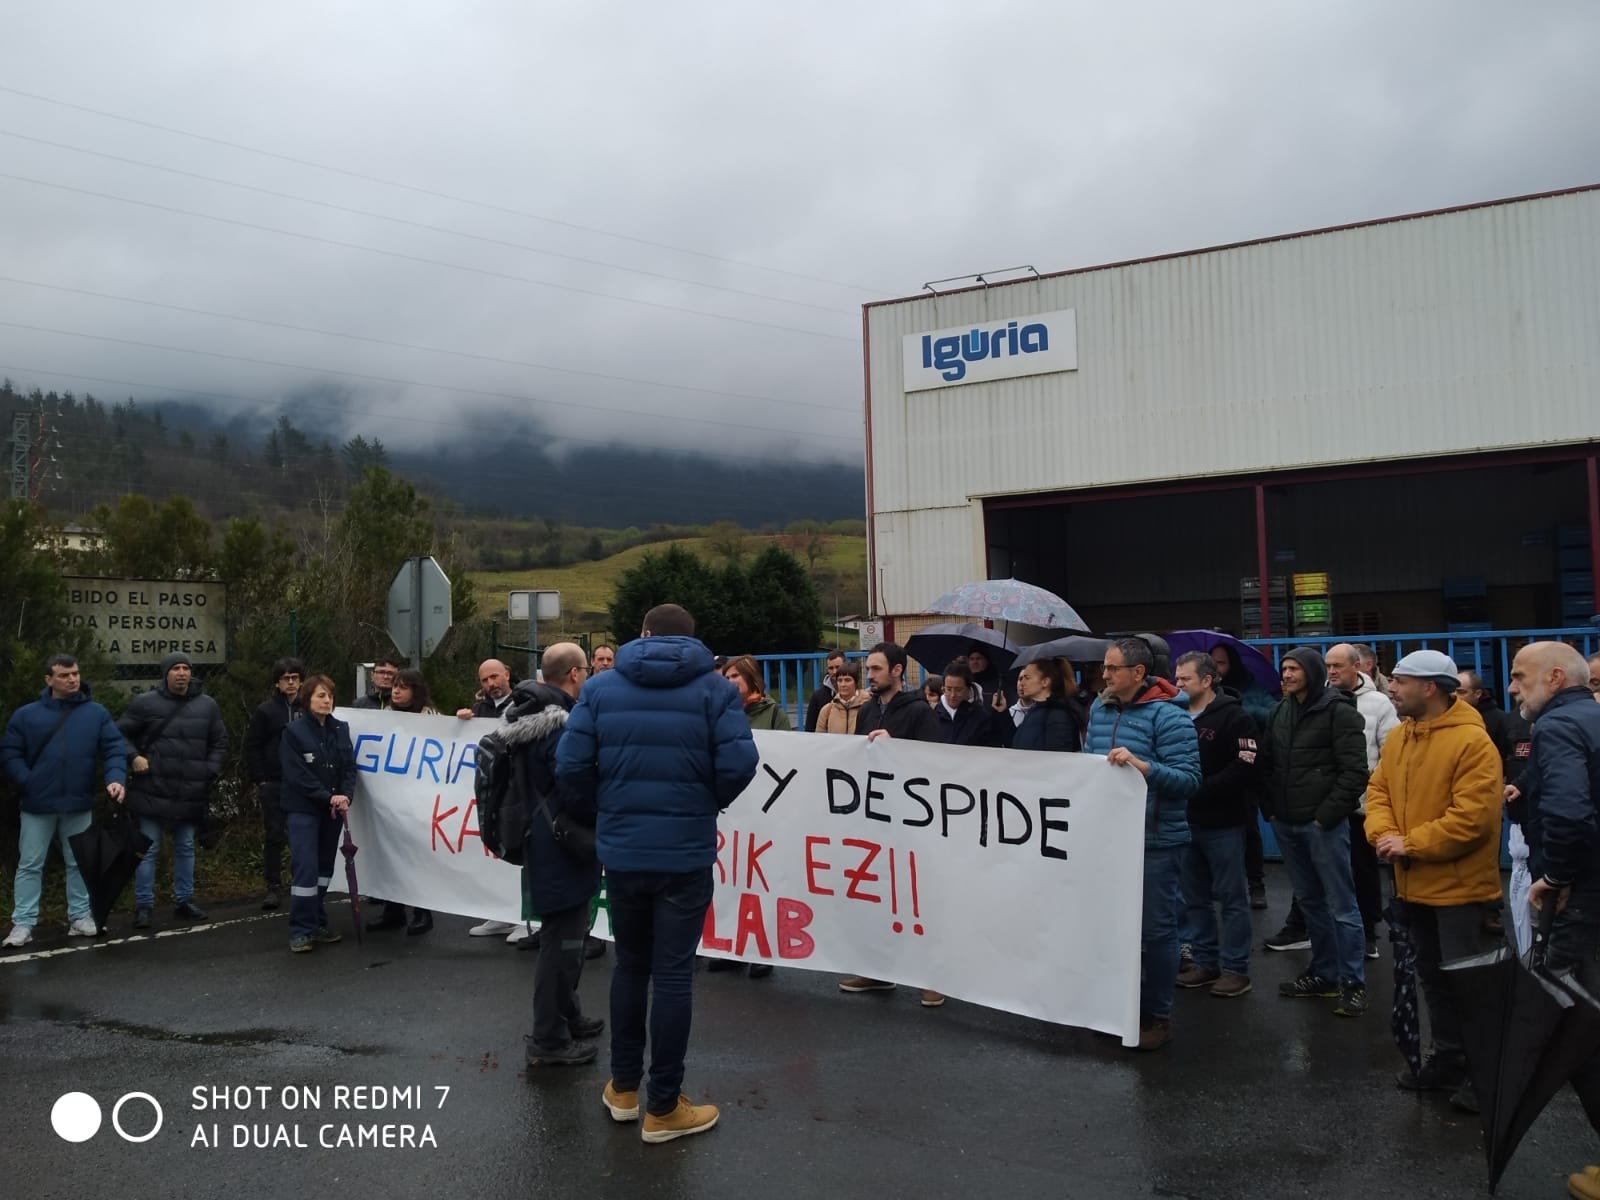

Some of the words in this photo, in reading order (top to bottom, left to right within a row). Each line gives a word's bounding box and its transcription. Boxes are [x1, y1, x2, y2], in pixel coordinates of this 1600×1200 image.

[922, 321, 1049, 382] Iguria
[108, 615, 197, 630] PERSONA
[128, 591, 149, 605] EL
[159, 592, 207, 607] PASO
[131, 639, 217, 654] EMPRESA
[761, 763, 797, 813] Y
[826, 768, 1071, 860] DESPIDE
[805, 835, 924, 936] EZ!!
[702, 892, 815, 960] LAB
